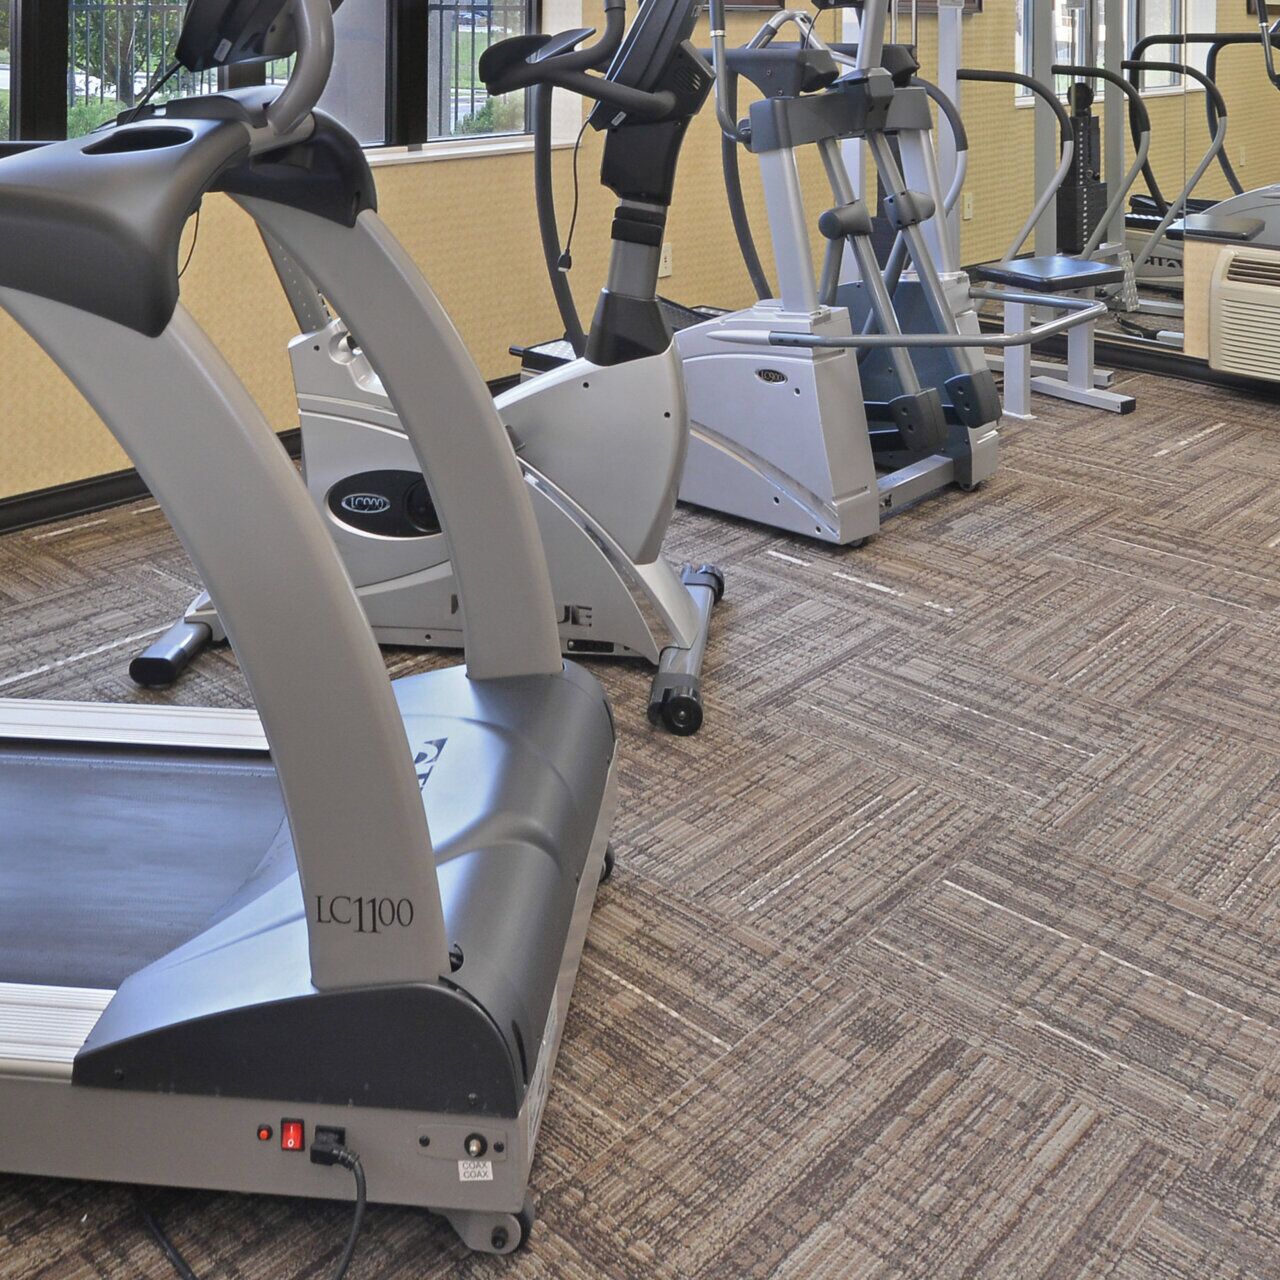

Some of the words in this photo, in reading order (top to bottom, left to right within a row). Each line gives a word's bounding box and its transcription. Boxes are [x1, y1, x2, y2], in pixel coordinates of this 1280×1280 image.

[315, 895, 414, 934] LC1100
[462, 1161, 488, 1169] COAX
[463, 1170, 489, 1179] COAX
